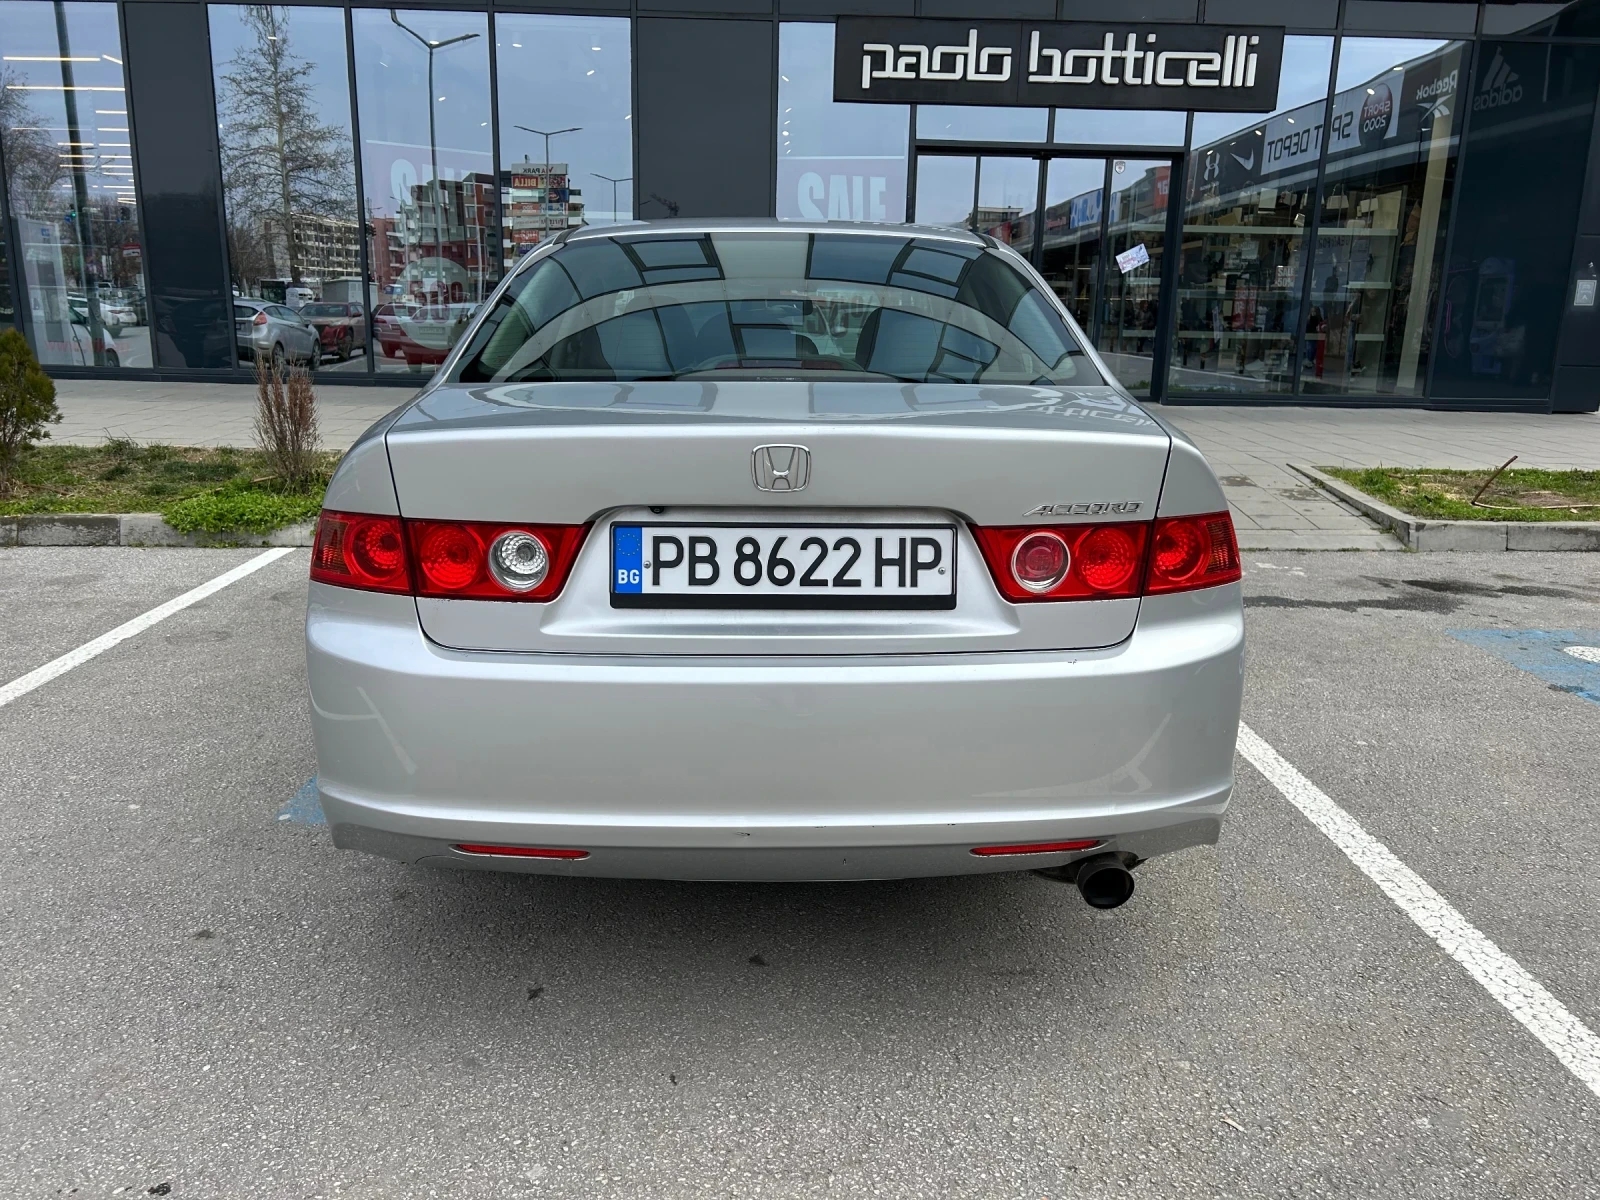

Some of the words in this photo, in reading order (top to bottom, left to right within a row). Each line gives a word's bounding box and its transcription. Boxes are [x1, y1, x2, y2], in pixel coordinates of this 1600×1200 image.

[861, 28, 1012, 89] paolo
[1027, 30, 1260, 88] botticelli
[1022, 501, 1144, 517] ACCORD
[618, 569, 640, 585] BG
[652, 535, 720, 587] PB
[733, 536, 862, 588] 8622
[874, 537, 942, 588] HP
